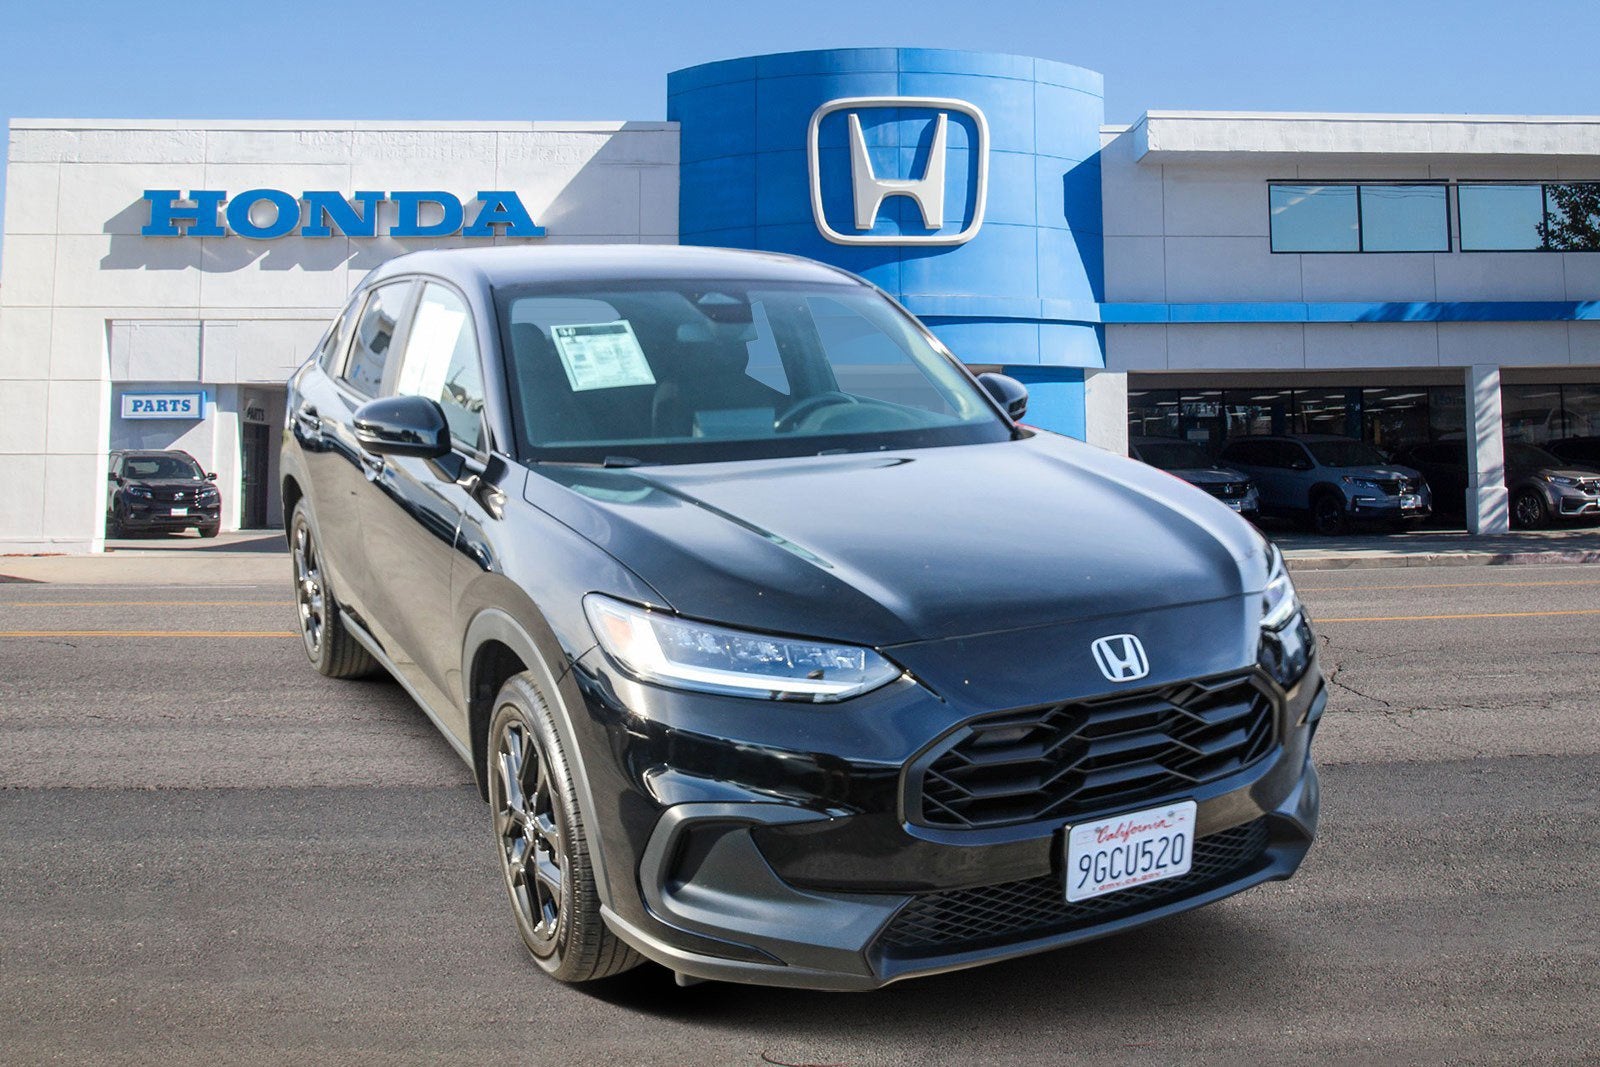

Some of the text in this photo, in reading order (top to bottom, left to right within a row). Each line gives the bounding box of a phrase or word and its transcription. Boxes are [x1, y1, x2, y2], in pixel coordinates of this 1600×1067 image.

[141, 188, 548, 240] HONDA
[132, 399, 191, 413] PARTS
[1096, 818, 1173, 844] California
[1077, 832, 1186, 889] 9GCU520
